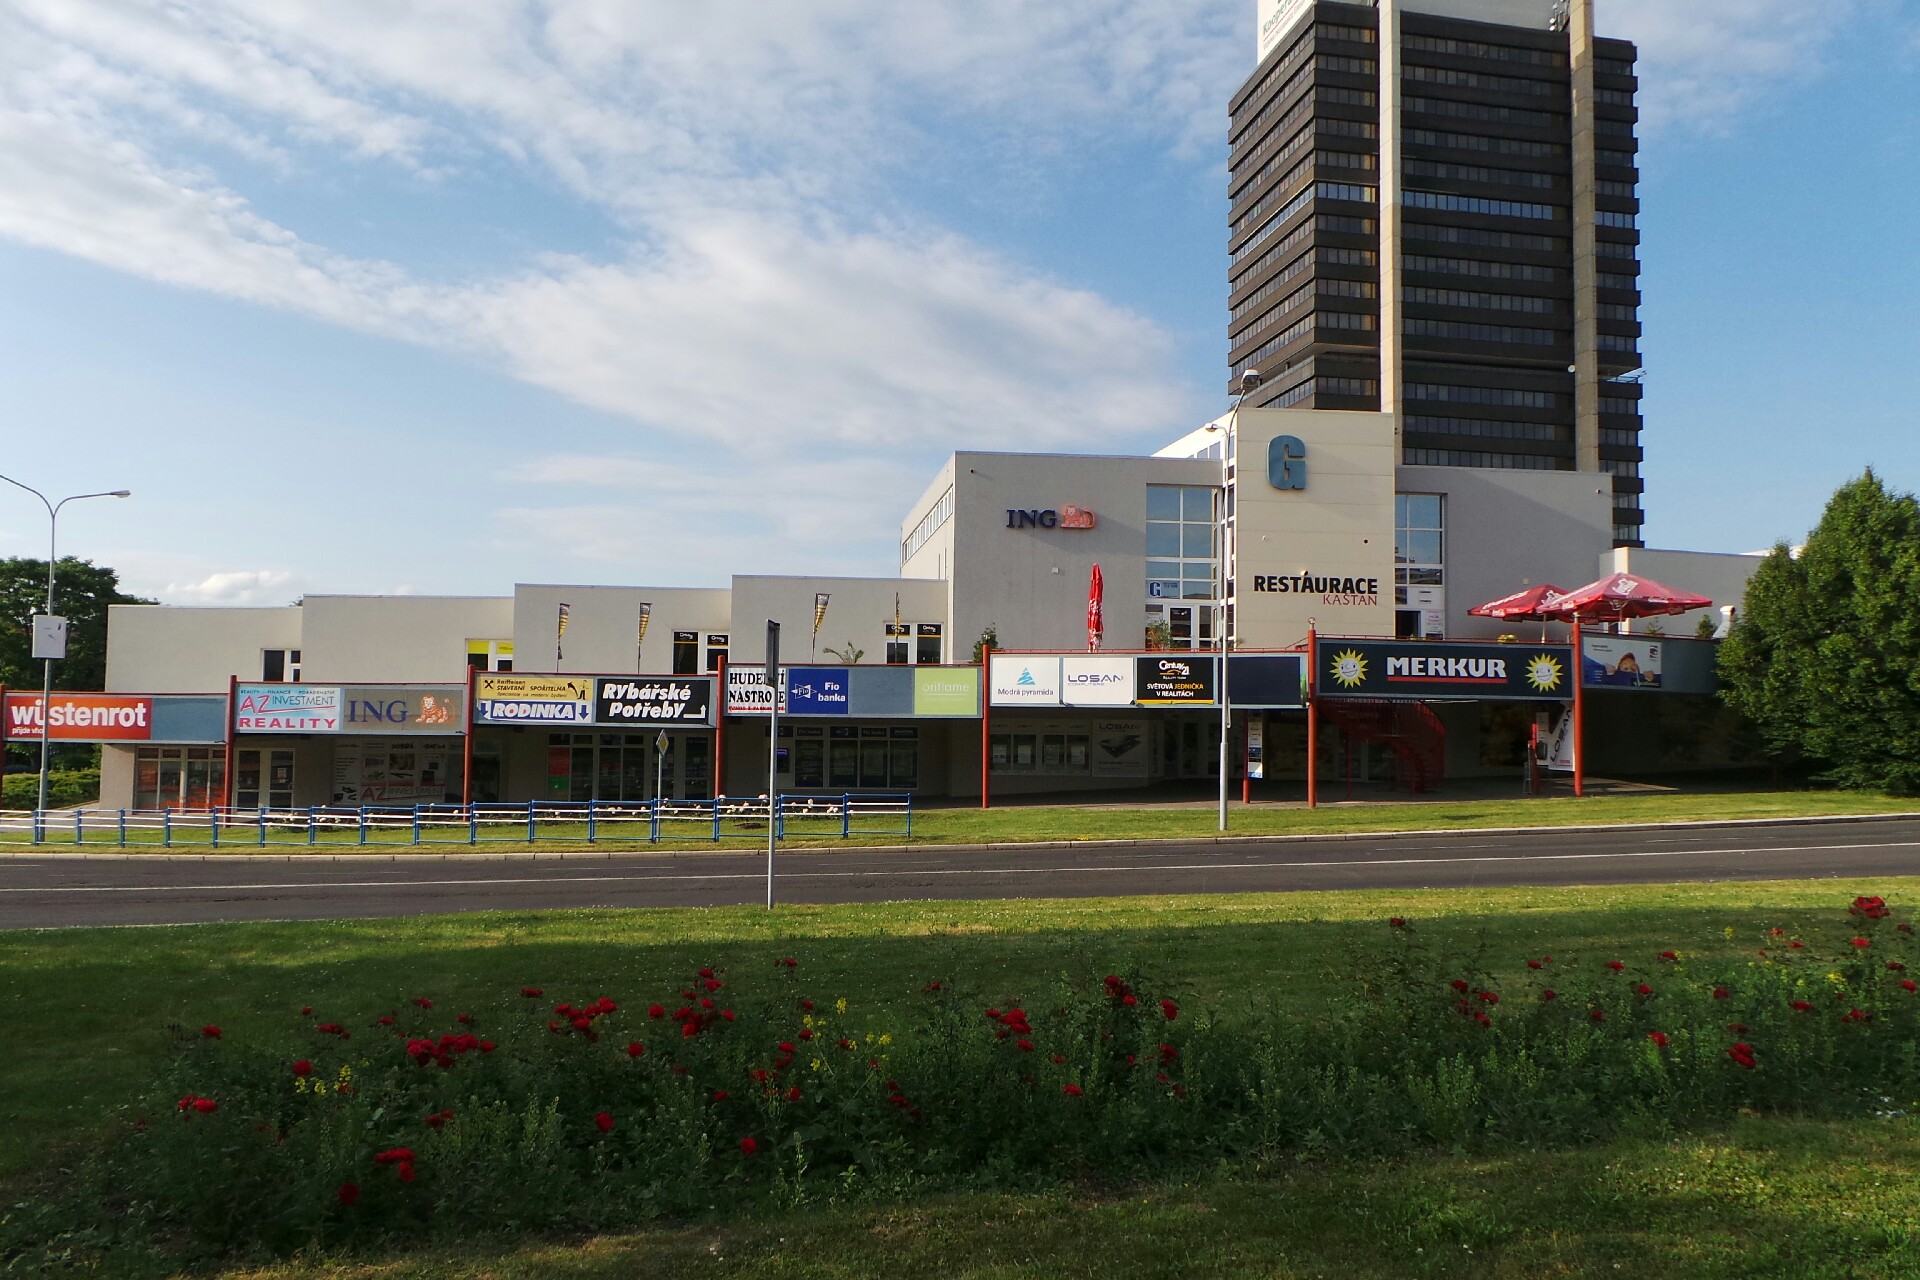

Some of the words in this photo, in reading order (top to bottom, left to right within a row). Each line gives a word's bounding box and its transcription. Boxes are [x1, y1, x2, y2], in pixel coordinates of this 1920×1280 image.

[1266, 434, 1306, 490] G
[1006, 509, 1057, 528] ING
[1149, 582, 1161, 597] G
[1254, 575, 1378, 594] RESTAURACE
[1323, 592, 1378, 606] KAŠTAN
[1386, 656, 1507, 678] MERKUR
[729, 670, 785, 685] HUDEÍ
[1068, 674, 1123, 683] LOSAN
[825, 682, 840, 691] Fio
[923, 681, 970, 692] oriflame
[997, 688, 1020, 696] Modrá
[1021, 688, 1054, 698] pyramida
[1147, 681, 1174, 690] SVĚTOVÁ
[1174, 681, 1204, 690] JEDNIČKA
[1161, 689, 1194, 697] REALITÁCH
[729, 687, 785, 704] NÁSTROE
[818, 693, 846, 702] banka
[240, 695, 270, 713] AZ
[272, 696, 335, 706] INVESTMENT
[348, 700, 409, 723] ING
[492, 703, 574, 719] RODINKA
[239, 717, 337, 729] REALITY
